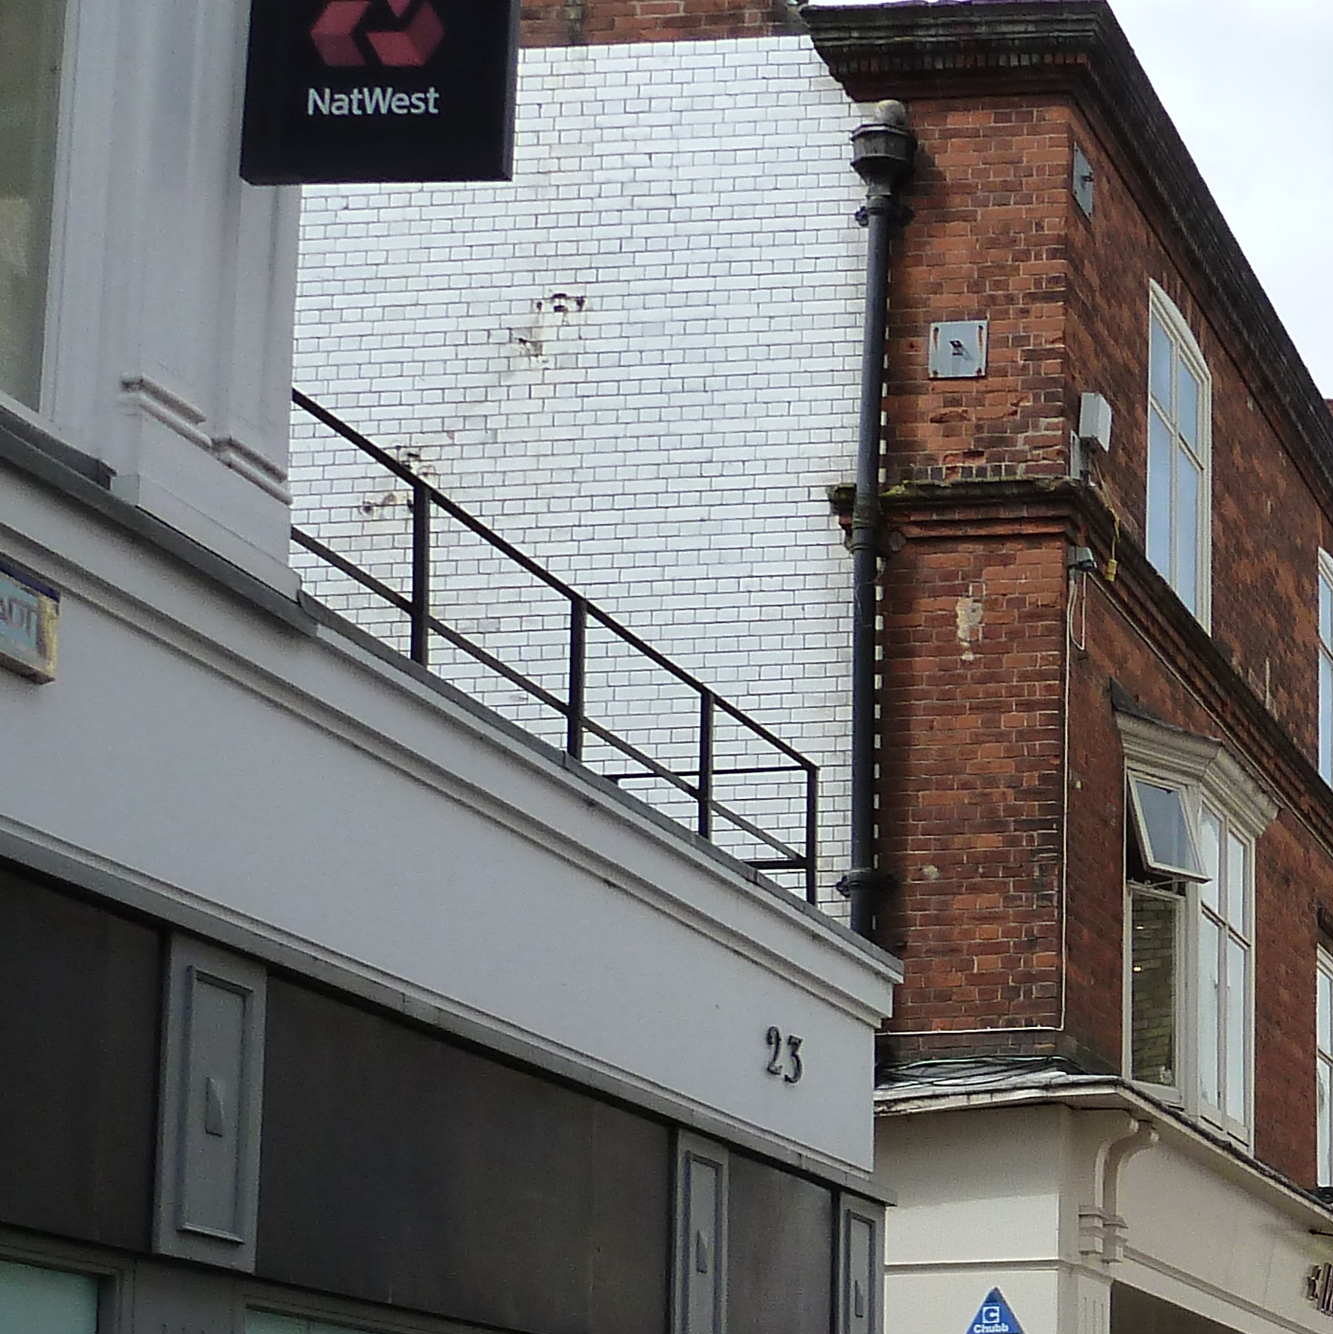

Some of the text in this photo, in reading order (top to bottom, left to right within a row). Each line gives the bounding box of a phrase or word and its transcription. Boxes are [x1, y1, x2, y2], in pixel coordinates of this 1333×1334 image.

[307, 86, 440, 116] NatWest
[766, 1025, 804, 1084] 23
[974, 1323, 1009, 1333] Chubb
